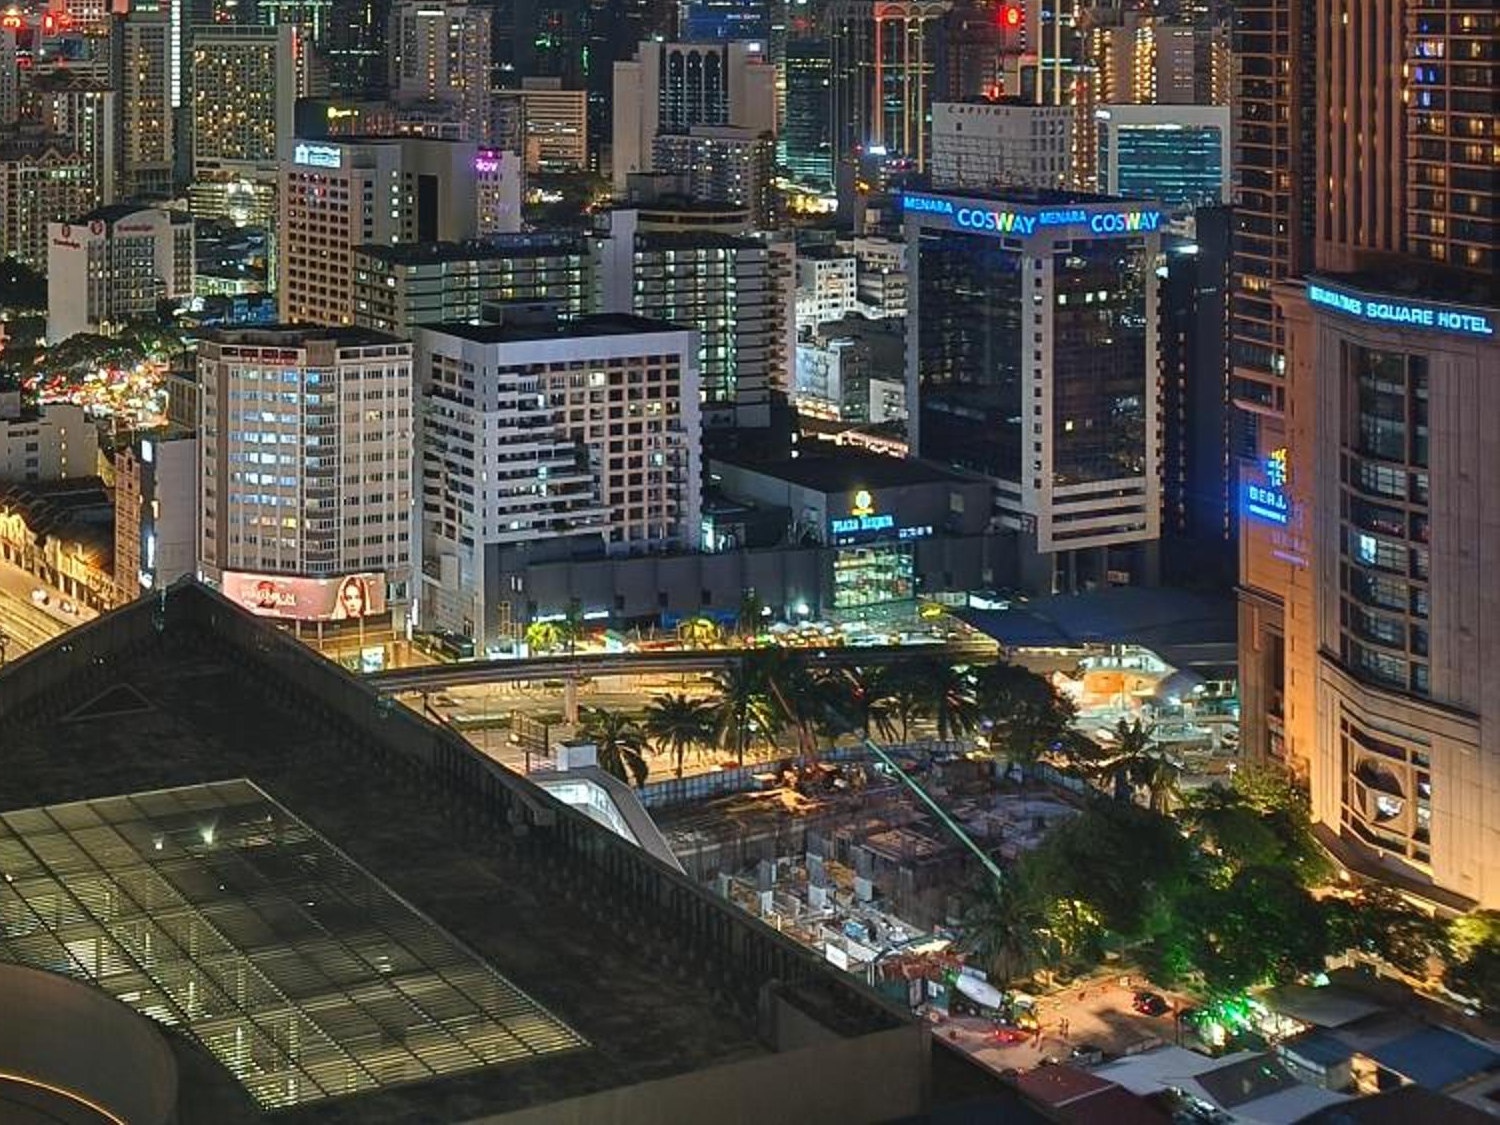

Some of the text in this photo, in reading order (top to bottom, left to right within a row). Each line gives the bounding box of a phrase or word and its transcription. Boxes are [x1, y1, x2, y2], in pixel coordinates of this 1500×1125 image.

[904, 196, 1036, 235] MENARA COSWAY
[1039, 209, 1160, 233] MENARA COSWAY
[1367, 302, 1493, 334] SQUARE HOTEL
